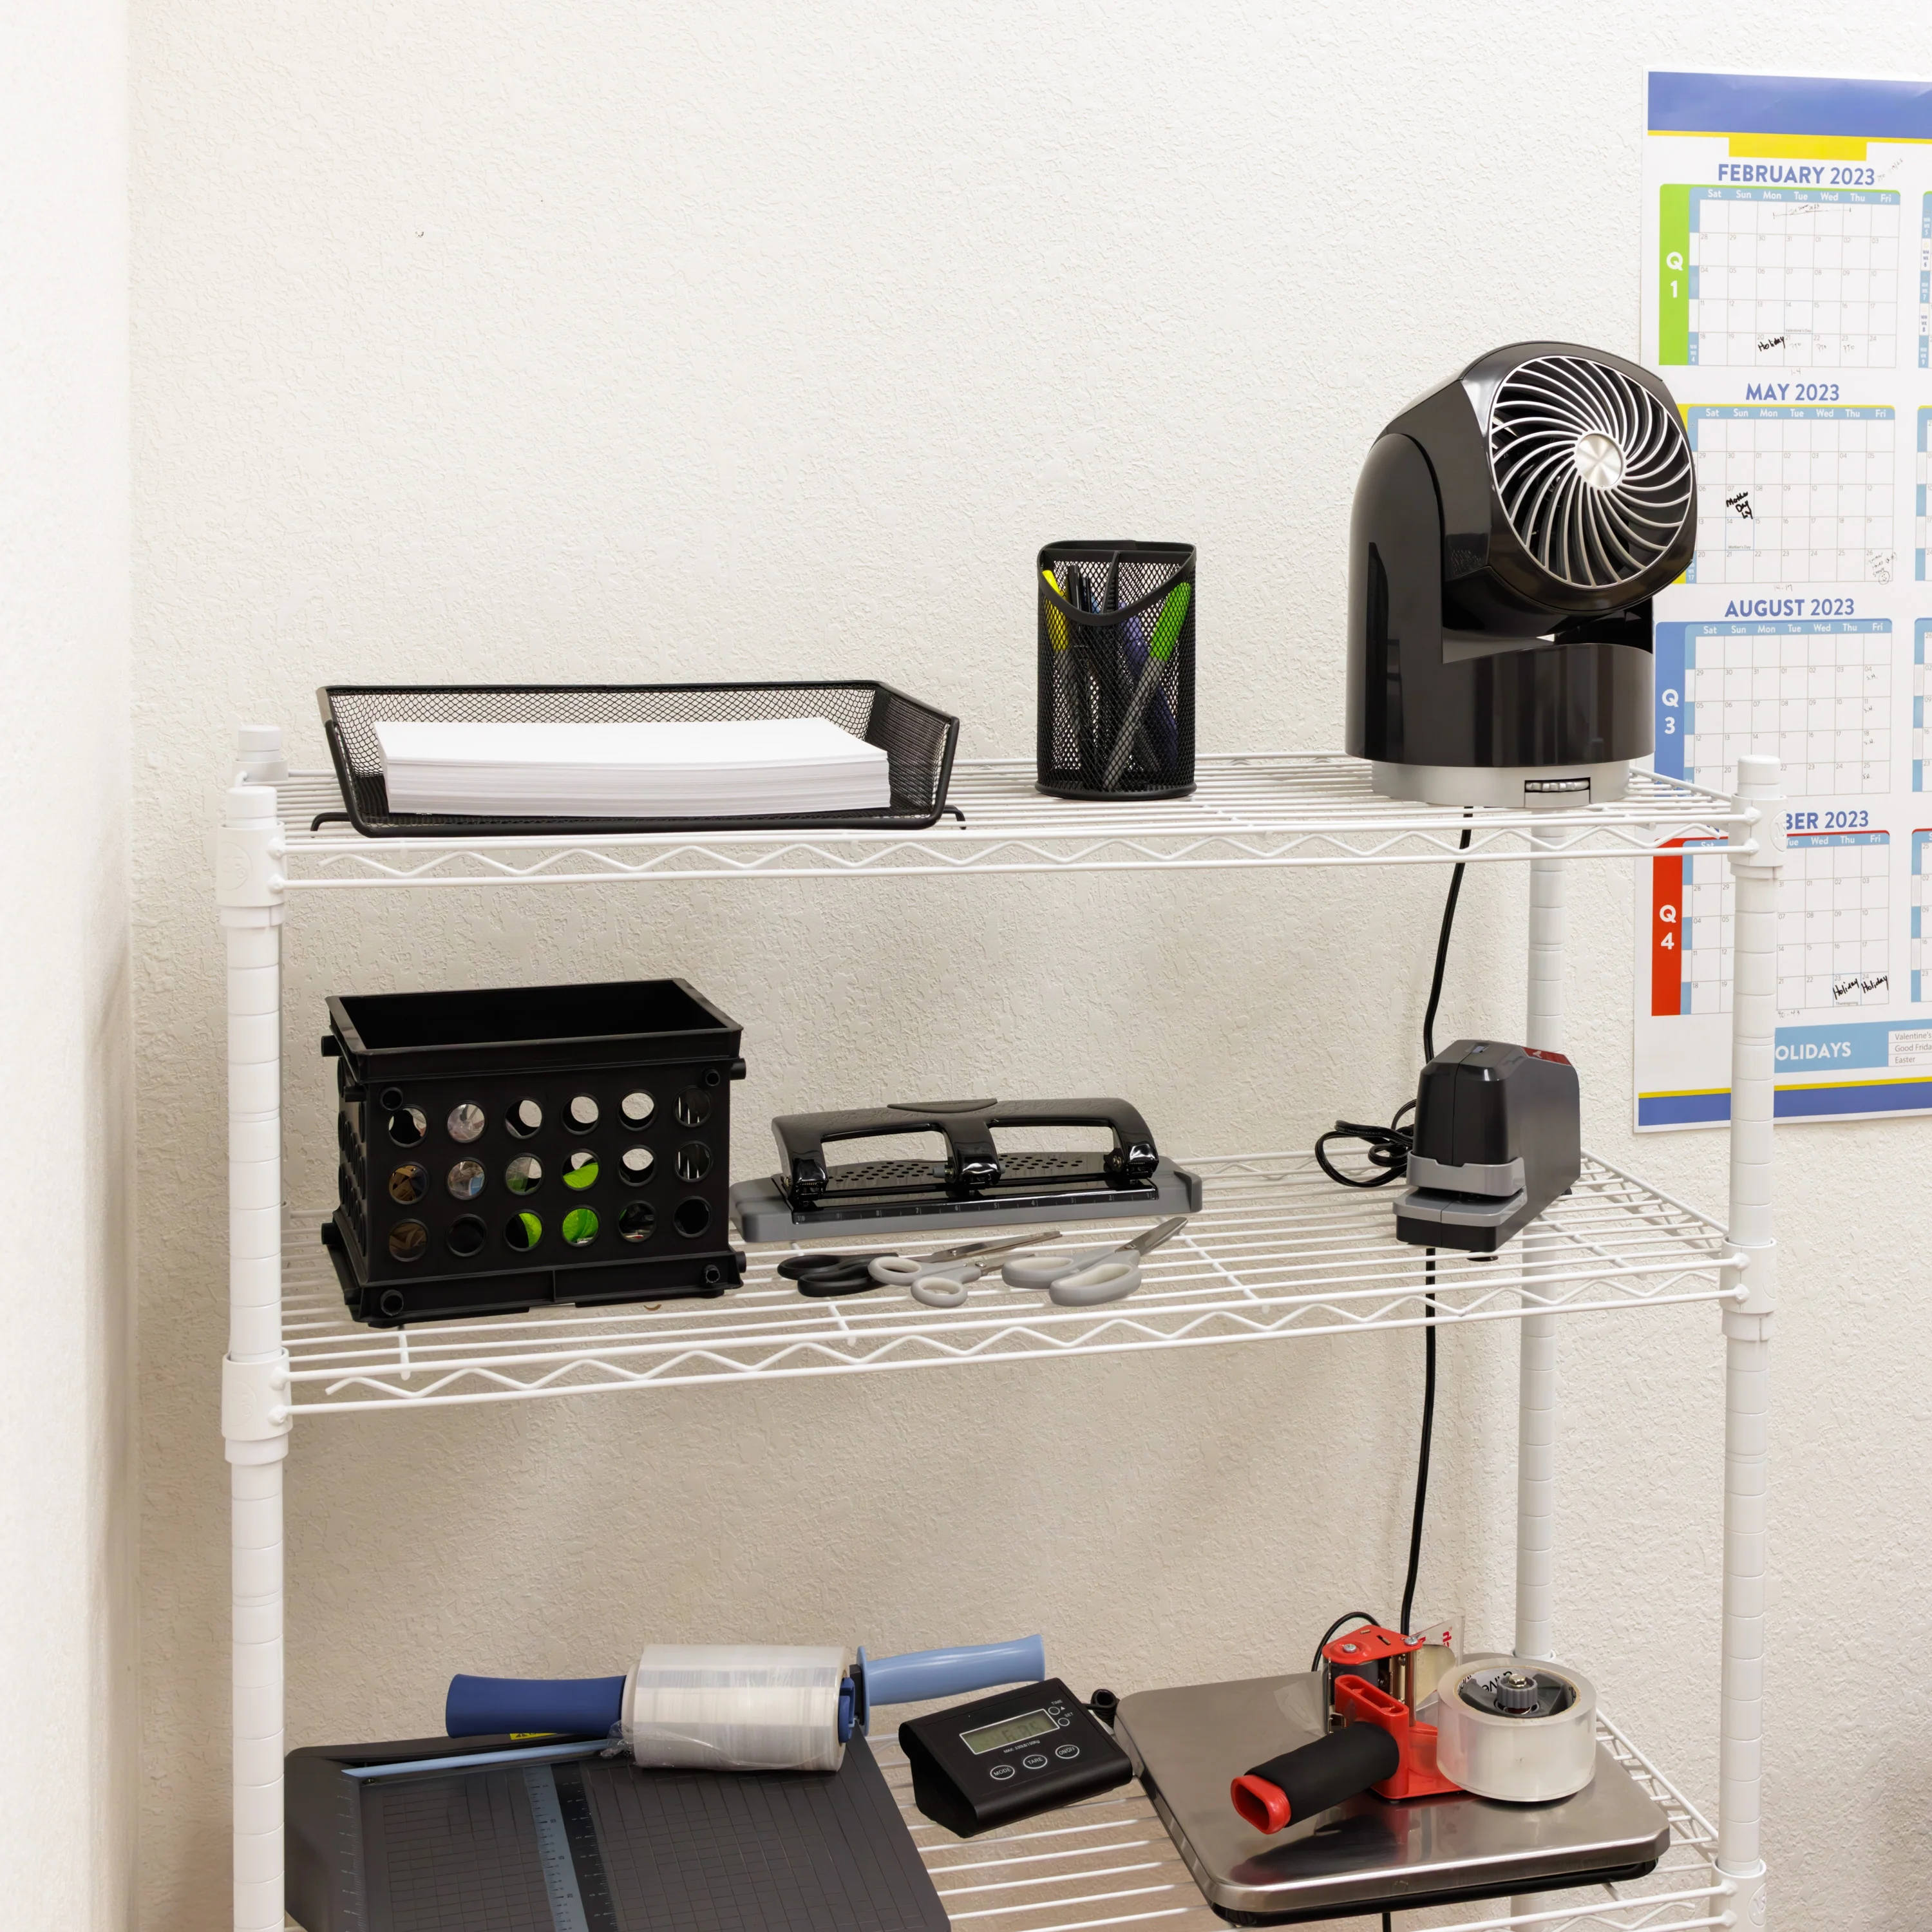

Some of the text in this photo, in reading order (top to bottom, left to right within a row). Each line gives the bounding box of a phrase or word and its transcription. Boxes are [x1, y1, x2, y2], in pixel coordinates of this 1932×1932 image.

[1718, 164, 1874, 185] FEBRUARY 2023
[1708, 189, 1721, 198] Sat
[1736, 190, 1752, 198] Sun
[1794, 192, 1808, 200] Tue
[1850, 193, 1866, 202] Thu
[1667, 252, 1682, 270] Q
[1671, 281, 1677, 298] 1
[1757, 336, 1785, 352] Holiday
[1746, 384, 1839, 401] MAY 2023
[1706, 408, 1719, 417] Sat
[1790, 409, 1804, 417] Tue
[1725, 599, 1854, 617] AUGUST 2023
[1703, 626, 1717, 634] Sat
[1842, 623, 1857, 632] Thu
[1663, 689, 1678, 706] Q
[1665, 717, 1675, 734] 3
[1825, 810, 1868, 828] 2023
[1840, 836, 1855, 844] Thu
[1870, 835, 1880, 843] Fri
[1660, 905, 1676, 922] Q
[1662, 933, 1674, 949] 4
[1833, 978, 1859, 999] Holiday
[1861, 975, 1889, 993] Holiday
[1895, 1032, 1931, 1040] Valentine's
[1776, 1042, 1851, 1060] OLIDAYS
[1059, 1747, 1075, 1756] ON/OFF
[993, 1767, 1012, 1776] MODE
